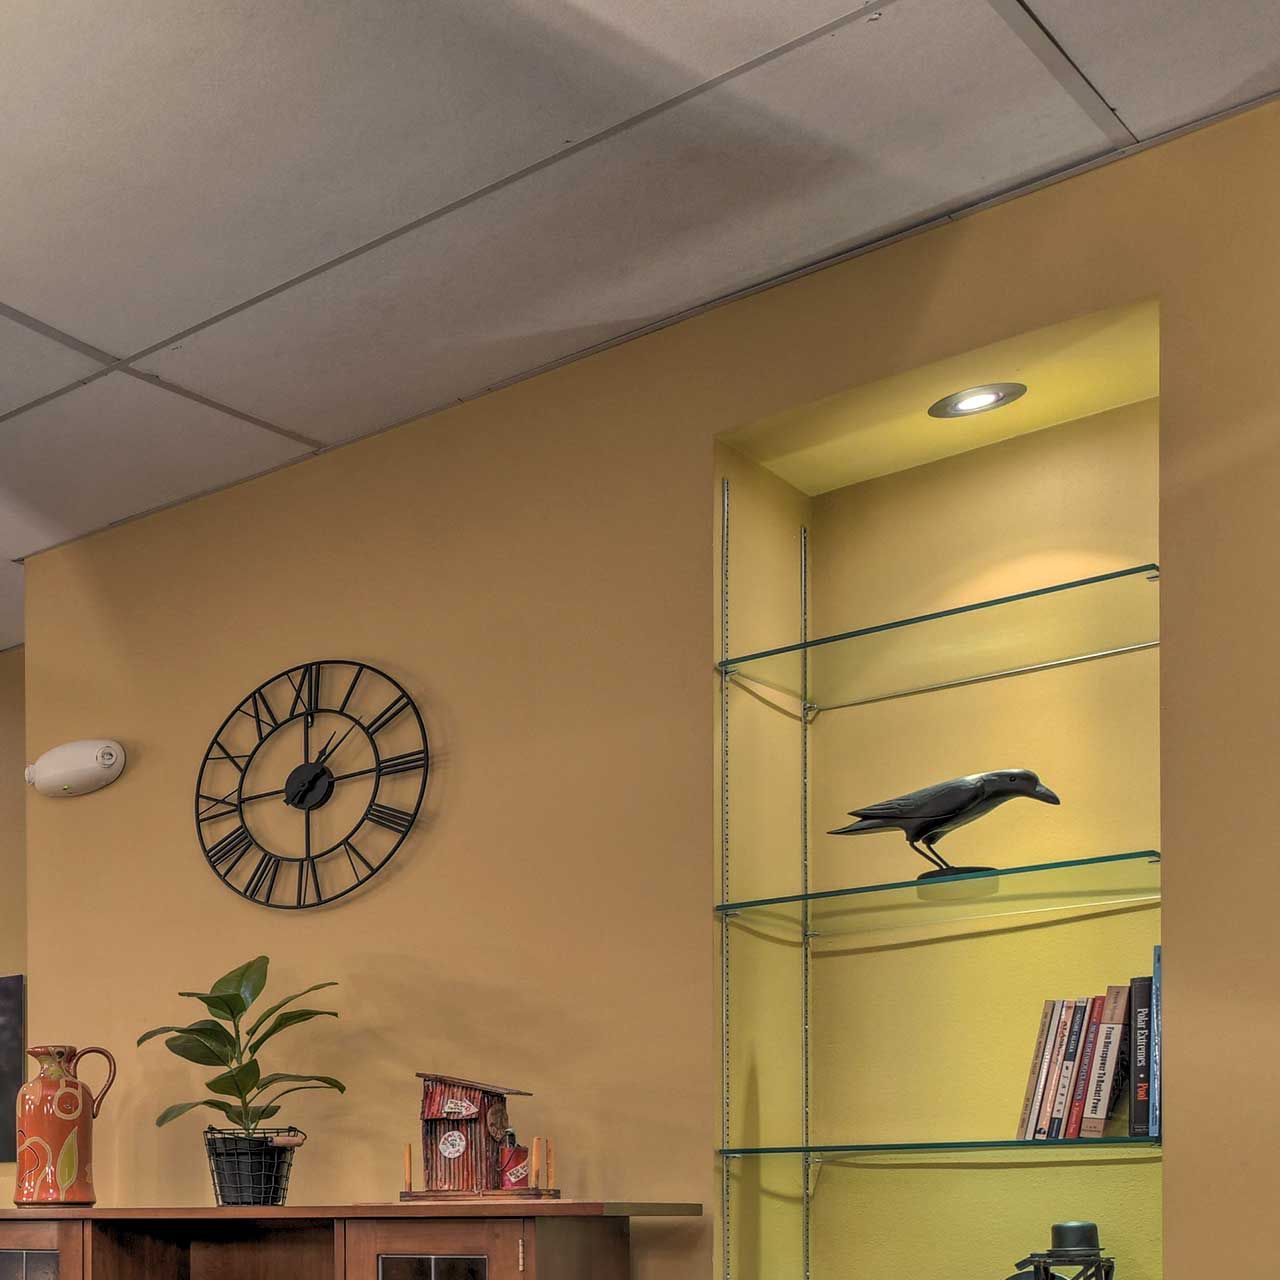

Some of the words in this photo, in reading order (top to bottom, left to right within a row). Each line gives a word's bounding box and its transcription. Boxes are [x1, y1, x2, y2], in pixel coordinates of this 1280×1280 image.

[1136, 1007, 1148, 1028] Polar
[1135, 1029, 1148, 1066] Extremes
[1136, 1083, 1147, 1100] Pool
